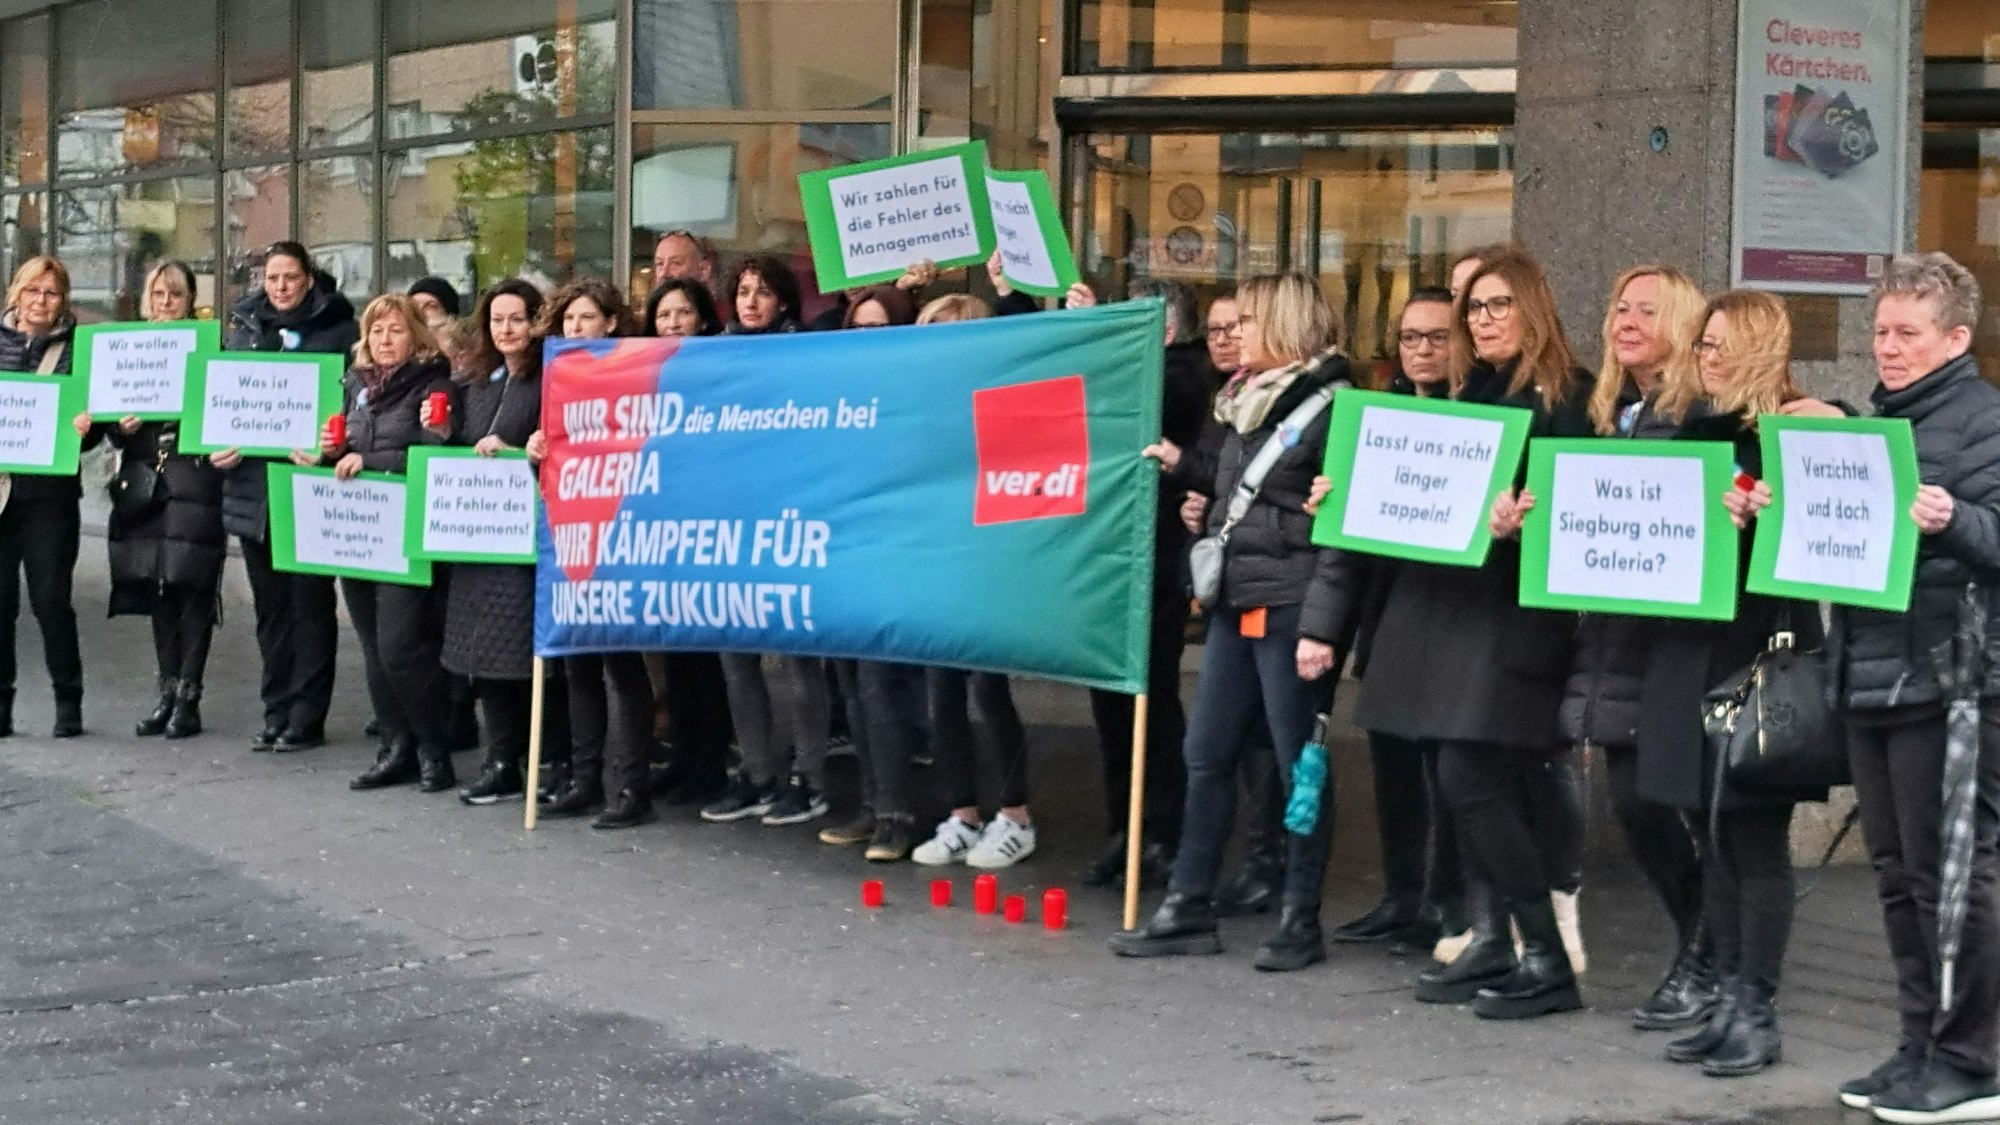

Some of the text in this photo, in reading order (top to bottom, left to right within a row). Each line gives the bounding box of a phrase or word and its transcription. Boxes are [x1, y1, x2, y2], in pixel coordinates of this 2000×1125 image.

[1766, 18, 1863, 50] Cleveres
[1766, 52, 1872, 83] Kärtchen.
[841, 175, 957, 208] Wir zahlen für
[847, 202, 961, 232] die Fehler des
[848, 222, 971, 258] Managements!
[108, 338, 178, 352] Wir wollen
[116, 357, 168, 371] bleiben!
[112, 378, 170, 391] Wie geht es
[238, 376, 288, 390] Was ist
[121, 393, 160, 405] weiter?
[211, 395, 313, 414] Siegburg ohne
[230, 417, 291, 432] Galeria?
[563, 393, 879, 445] WIR SIND die Menschen bei
[1365, 428, 1492, 461] Lasst uns nicht
[558, 451, 660, 501] GALERIA
[986, 463, 1081, 497] ver.di
[1394, 465, 1449, 492] länger
[1801, 456, 1870, 481] Verzichtet
[433, 472, 528, 489] Wir zahlen für
[1595, 479, 1662, 501] Was ist
[312, 484, 389, 503] Wir wollen
[432, 497, 527, 512] die Fehler des
[323, 508, 380, 523] bleiben!
[1379, 501, 1451, 524] zappeln!
[1806, 499, 1870, 521] und doch
[321, 529, 383, 544] Wie geht es
[429, 521, 529, 538] Managements!
[1558, 512, 1697, 540] Siegburg ohne
[554, 508, 831, 568] WIR KÄMPFEN FÜR
[1806, 536, 1866, 560] verloren!
[333, 549, 373, 561] weiter?
[1584, 548, 1666, 573] Galeria?
[552, 581, 815, 632] UNSERE ZUKUNFT!
